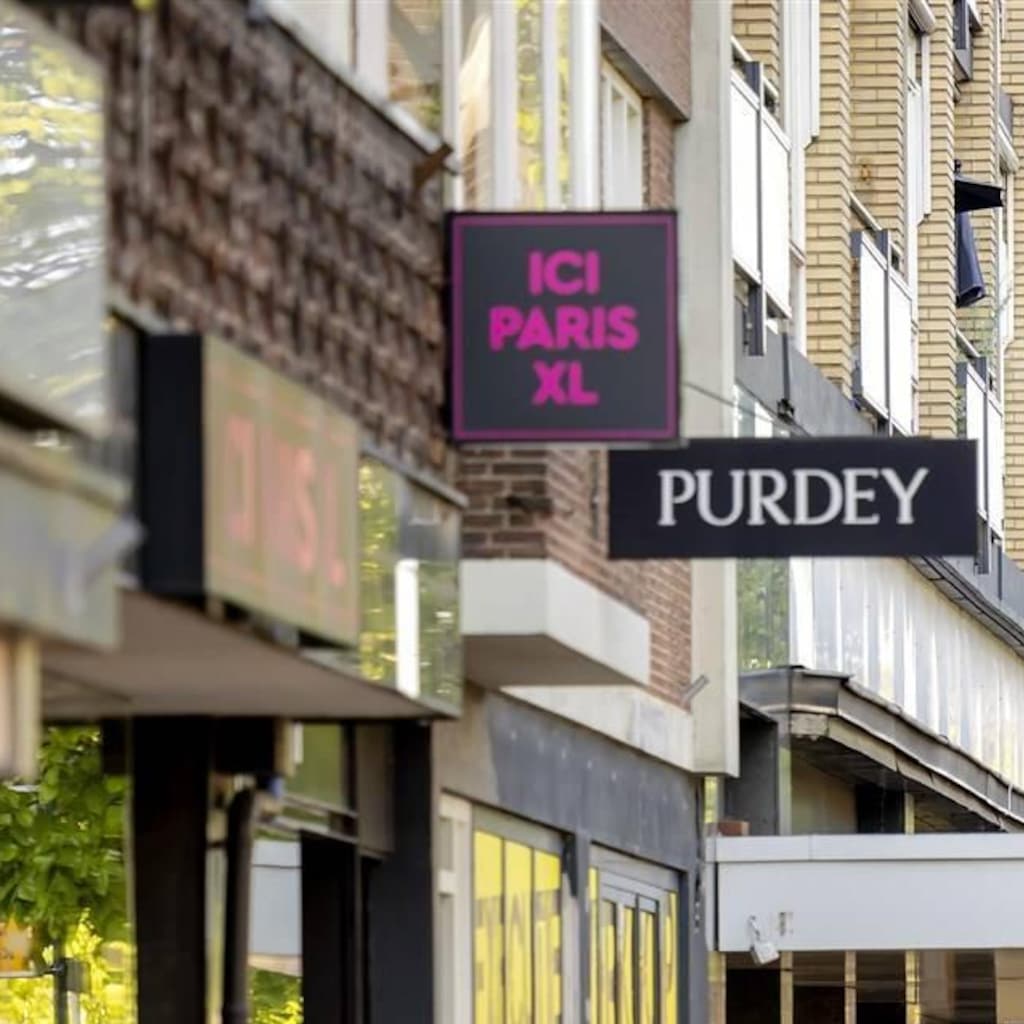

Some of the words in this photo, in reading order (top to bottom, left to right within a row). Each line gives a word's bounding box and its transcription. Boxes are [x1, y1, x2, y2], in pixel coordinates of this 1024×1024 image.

[528, 250, 599, 296] ICI
[489, 305, 639, 352] PARIS
[532, 361, 599, 407] XL
[656, 467, 930, 527] PURDEY
